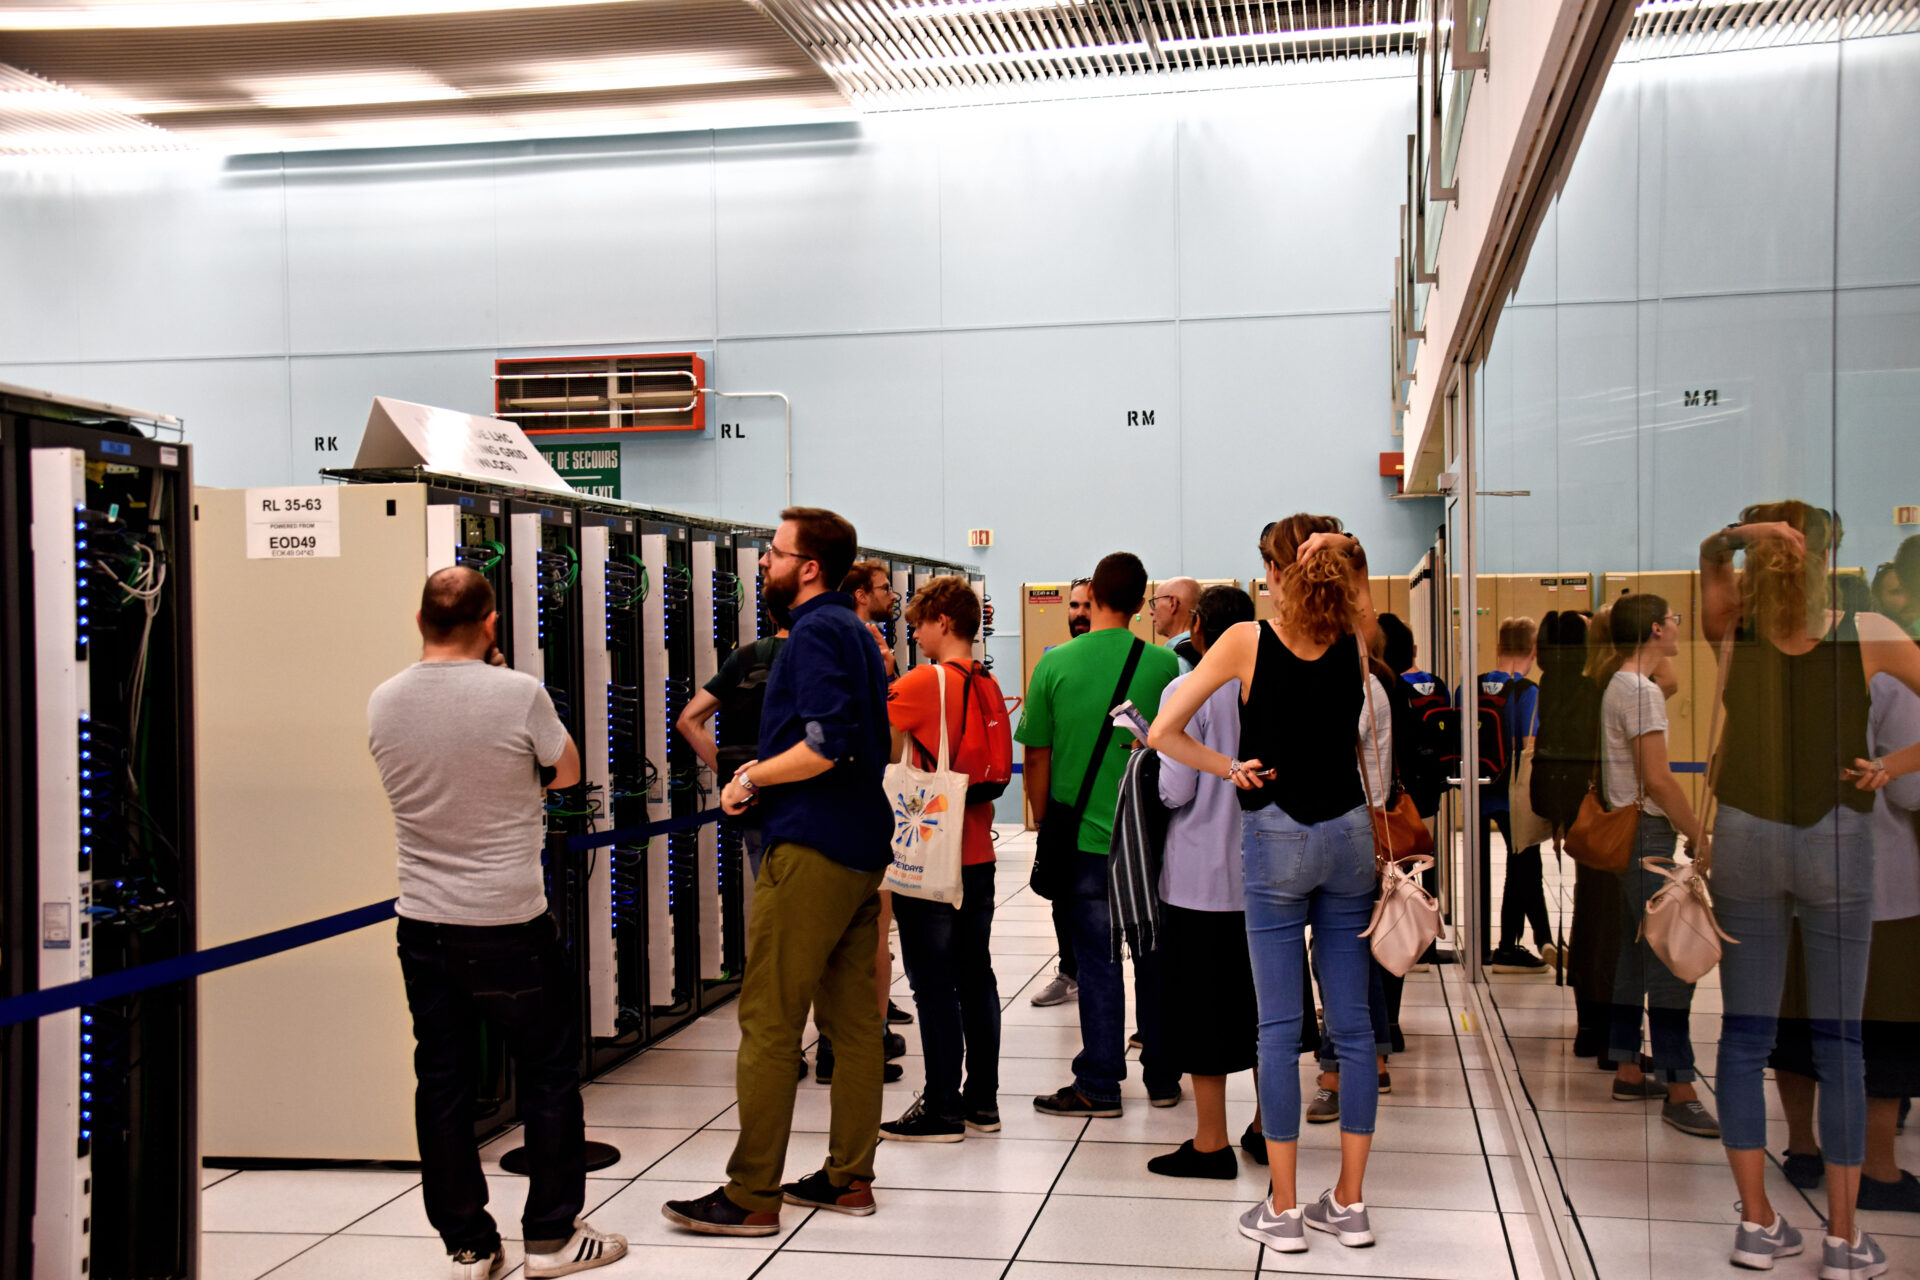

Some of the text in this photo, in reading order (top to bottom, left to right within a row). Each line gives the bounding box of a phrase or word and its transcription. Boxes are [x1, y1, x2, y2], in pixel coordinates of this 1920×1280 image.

[1127, 410, 1155, 426] RM
[488, 431, 513, 444] LHC
[721, 423, 746, 439] RL
[315, 436, 338, 451] RK
[499, 447, 528, 460] GRID
[557, 451, 570, 470] DE
[572, 450, 619, 469] SECOURS
[262, 498, 321, 511] RL 35-63
[269, 536, 316, 549] EOD49
